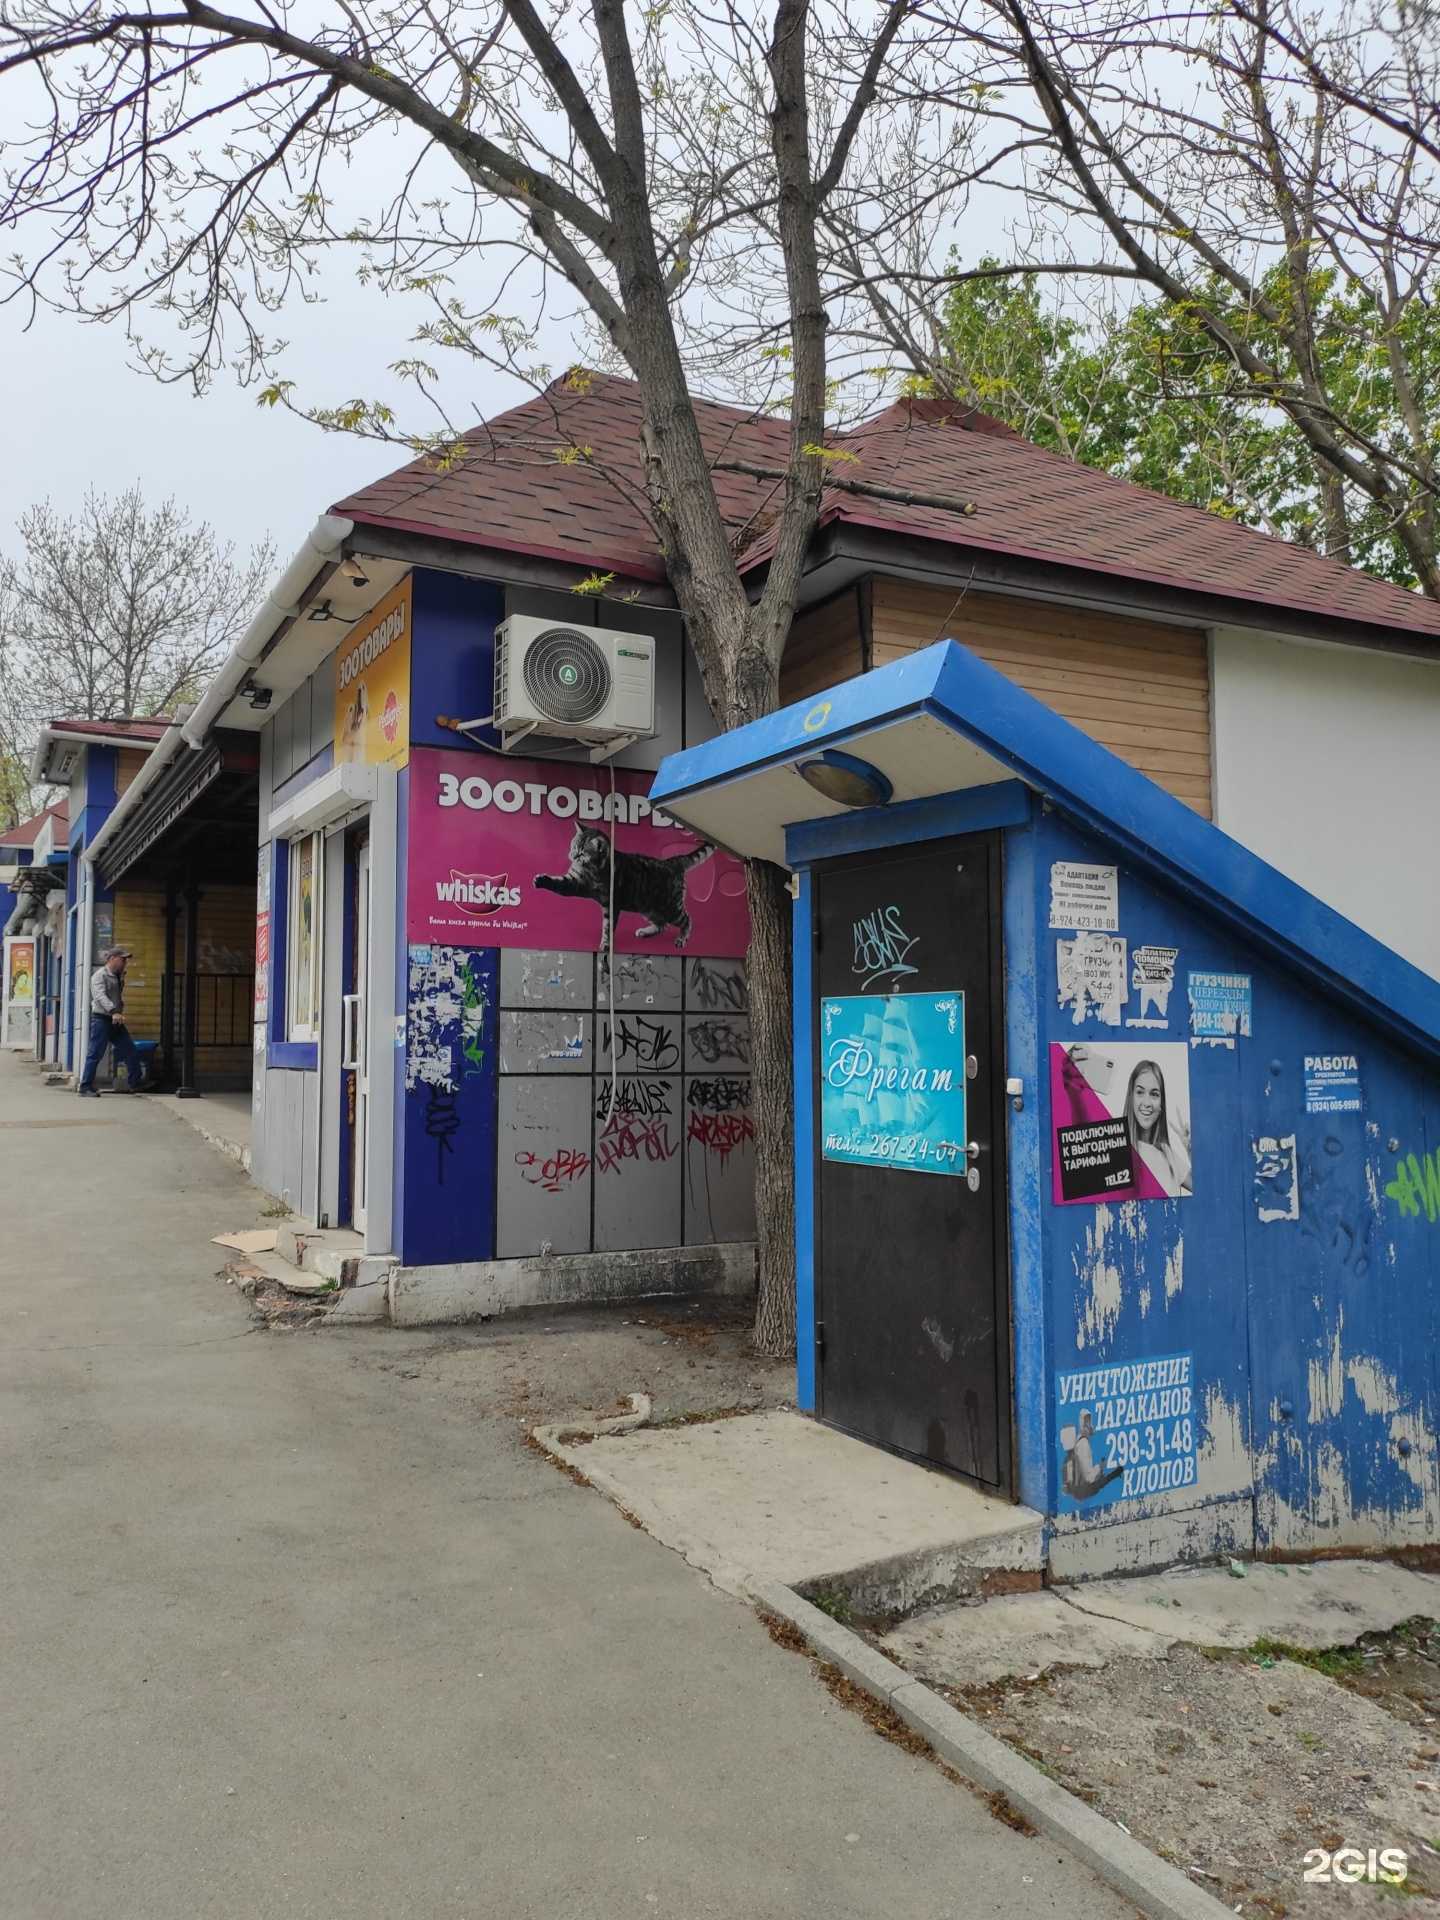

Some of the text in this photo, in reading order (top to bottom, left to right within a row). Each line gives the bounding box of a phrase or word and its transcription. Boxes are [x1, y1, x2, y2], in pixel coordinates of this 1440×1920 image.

[339, 602, 406, 690] ЗООТОВАРЫ
[436, 879, 521, 906] whiskas
[1190, 974, 1249, 988] ГРУЗЧИКИ
[828, 1039, 952, 1102] Фрегат
[1304, 1056, 1358, 1071] РАБОТА
[1061, 1122, 1124, 1143] ПОДКЛЮЧИМ
[1063, 1136, 1127, 1157] К ВЫГОДНЫМ
[1064, 1153, 1110, 1171] ТАРИФАМ
[1105, 1169, 1130, 1186] TELE2
[1060, 1356, 1190, 1405] УНИЧТОЖЕНИЕ
[1095, 1386, 1192, 1431] ТАРАКАНОВ
[1106, 1418, 1193, 1469] 298-31-48
[1121, 1456, 1194, 1497] КЛОПОВ
